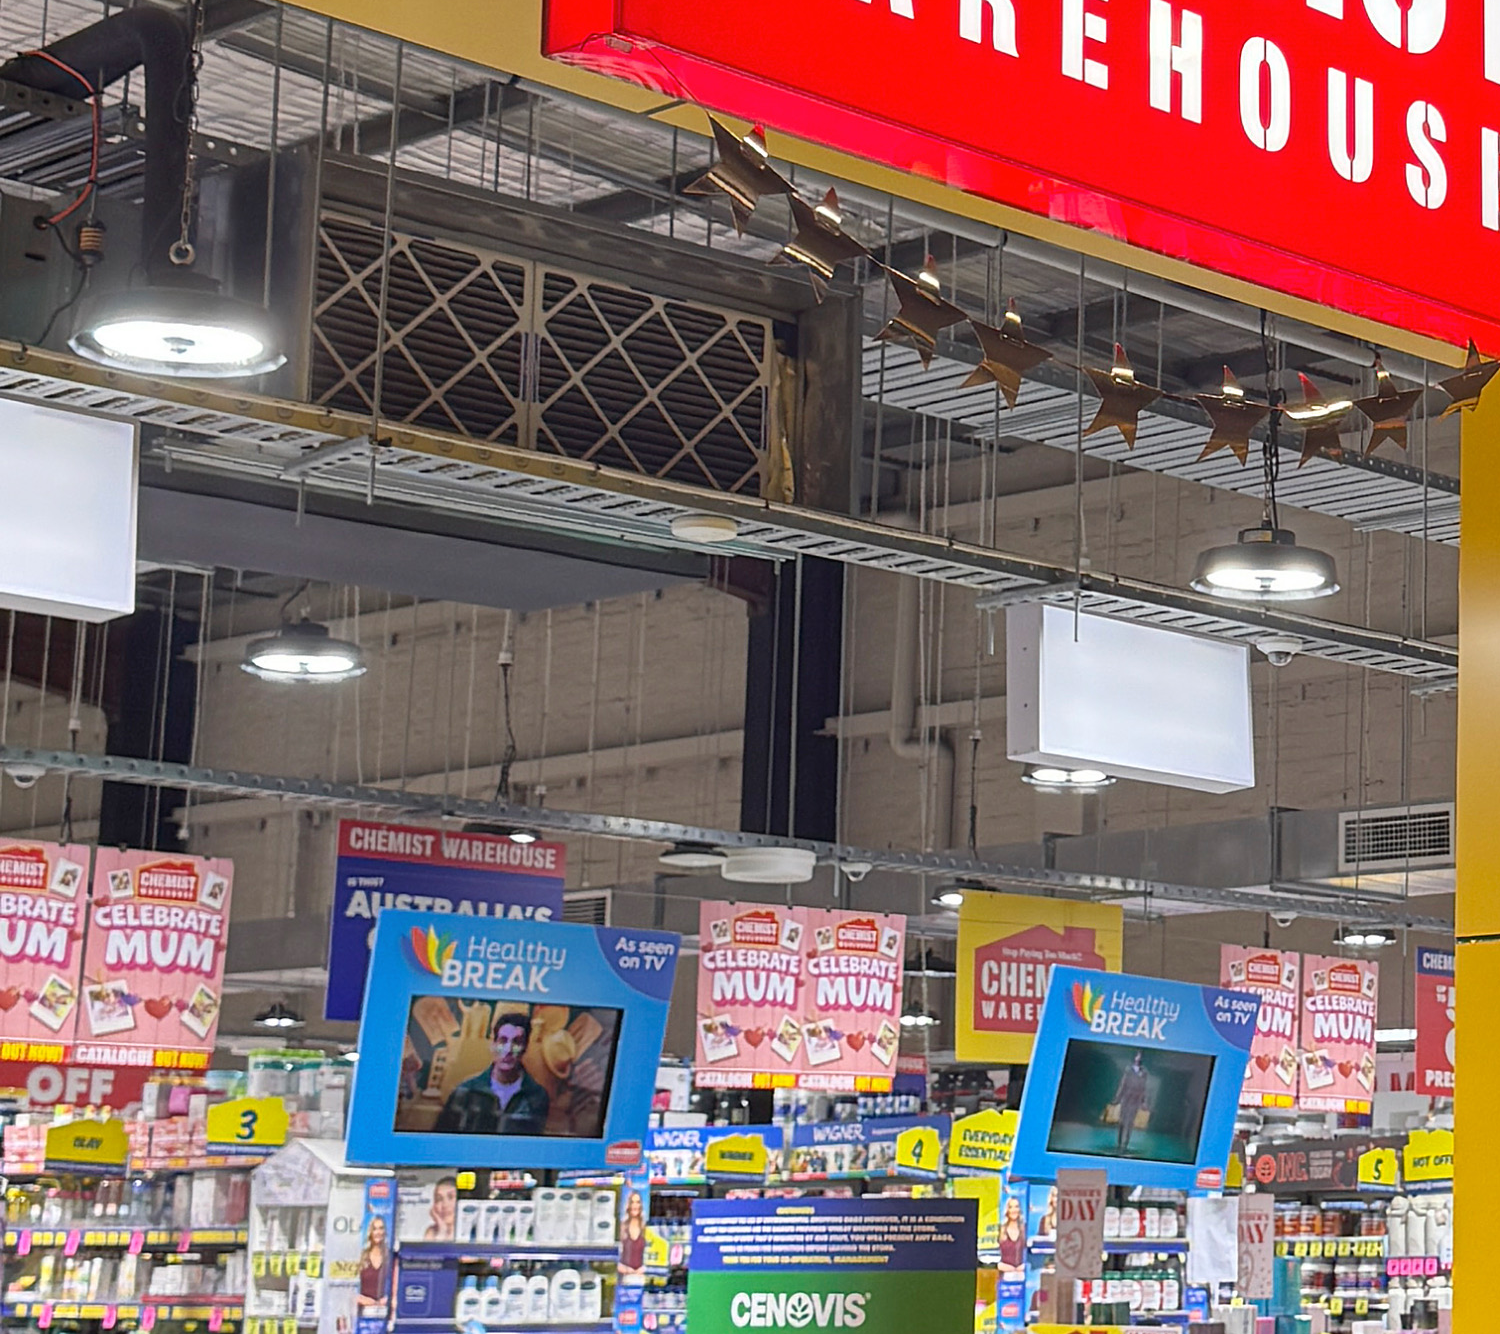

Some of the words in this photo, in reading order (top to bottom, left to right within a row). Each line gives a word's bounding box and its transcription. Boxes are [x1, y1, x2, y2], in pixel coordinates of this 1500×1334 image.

[350, 826, 434, 857] CHEMIST
[442, 834, 557, 870] WAREHOUSE
[0, 893, 76, 925] BRATE
[95, 904, 222, 935] CELEBRATE
[0, 920, 68, 962] UM
[105, 929, 215, 973] MUM
[468, 936, 567, 971] Healthy
[615, 937, 636, 953] As
[639, 941, 675, 956] seen
[441, 959, 550, 993] BREAK
[618, 956, 640, 970] on
[641, 956, 668, 972] TV
[702, 949, 800, 975] CELEBRATE
[808, 956, 897, 981] CELEBRATE
[713, 970, 796, 1006] MUM
[816, 979, 894, 1011] MUM
[1111, 990, 1180, 1021] Healthy
[1214, 996, 1229, 1009] As
[1231, 999, 1257, 1012] seen
[1216, 1012, 1231, 1023] on
[1234, 1012, 1251, 1026] TV
[1305, 995, 1375, 1017] CELEBRATE
[1091, 1009, 1167, 1041] BREAK
[1256, 1006, 1292, 1036] UM
[1313, 1012, 1372, 1044] MUM
[27, 1065, 115, 1105] OFF
[235, 1110, 258, 1140] 3
[911, 1139, 923, 1160] 4
[1373, 1158, 1383, 1181] 5
[1060, 1197, 1100, 1221] DAY
[333, 1216, 359, 1234] OL
[731, 1291, 867, 1328] CENOVIS
